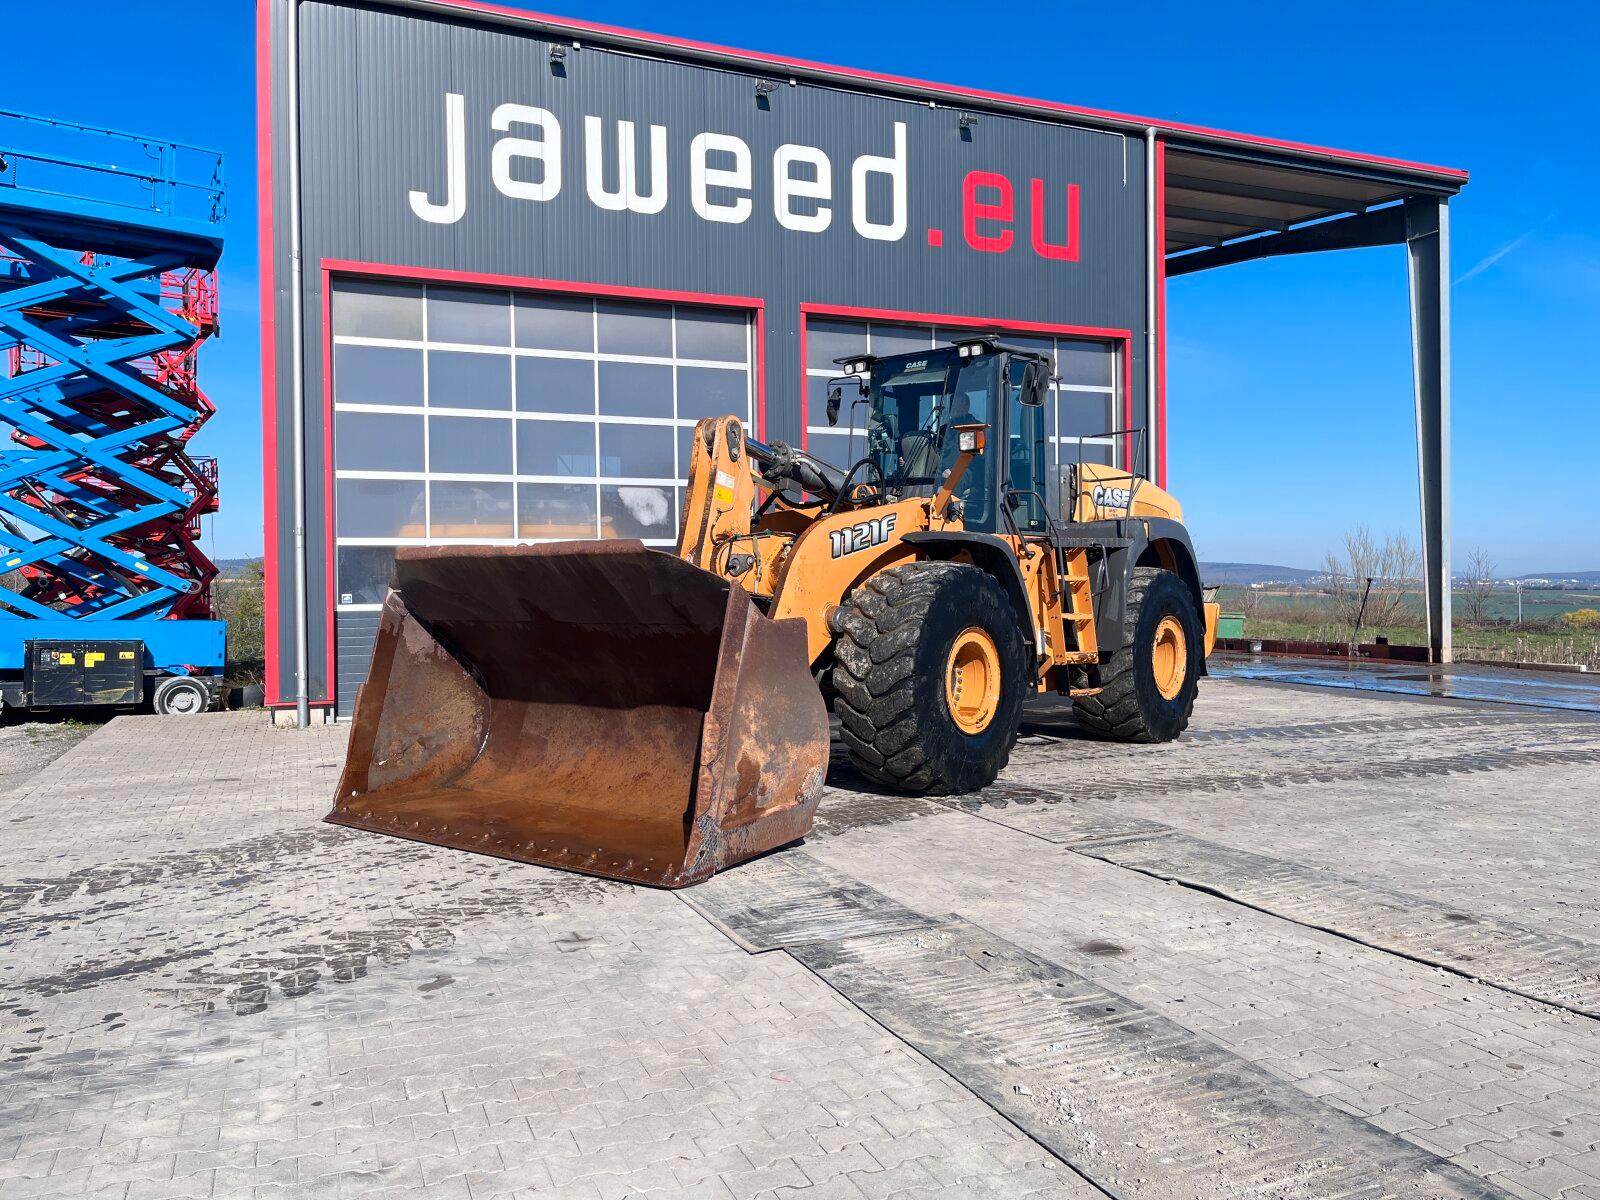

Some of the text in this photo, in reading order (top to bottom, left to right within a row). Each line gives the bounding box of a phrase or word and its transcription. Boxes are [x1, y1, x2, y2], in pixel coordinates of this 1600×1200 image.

[905, 360, 928, 369] CASE
[1093, 485, 1130, 509] CASE
[829, 512, 896, 559] 1121F
